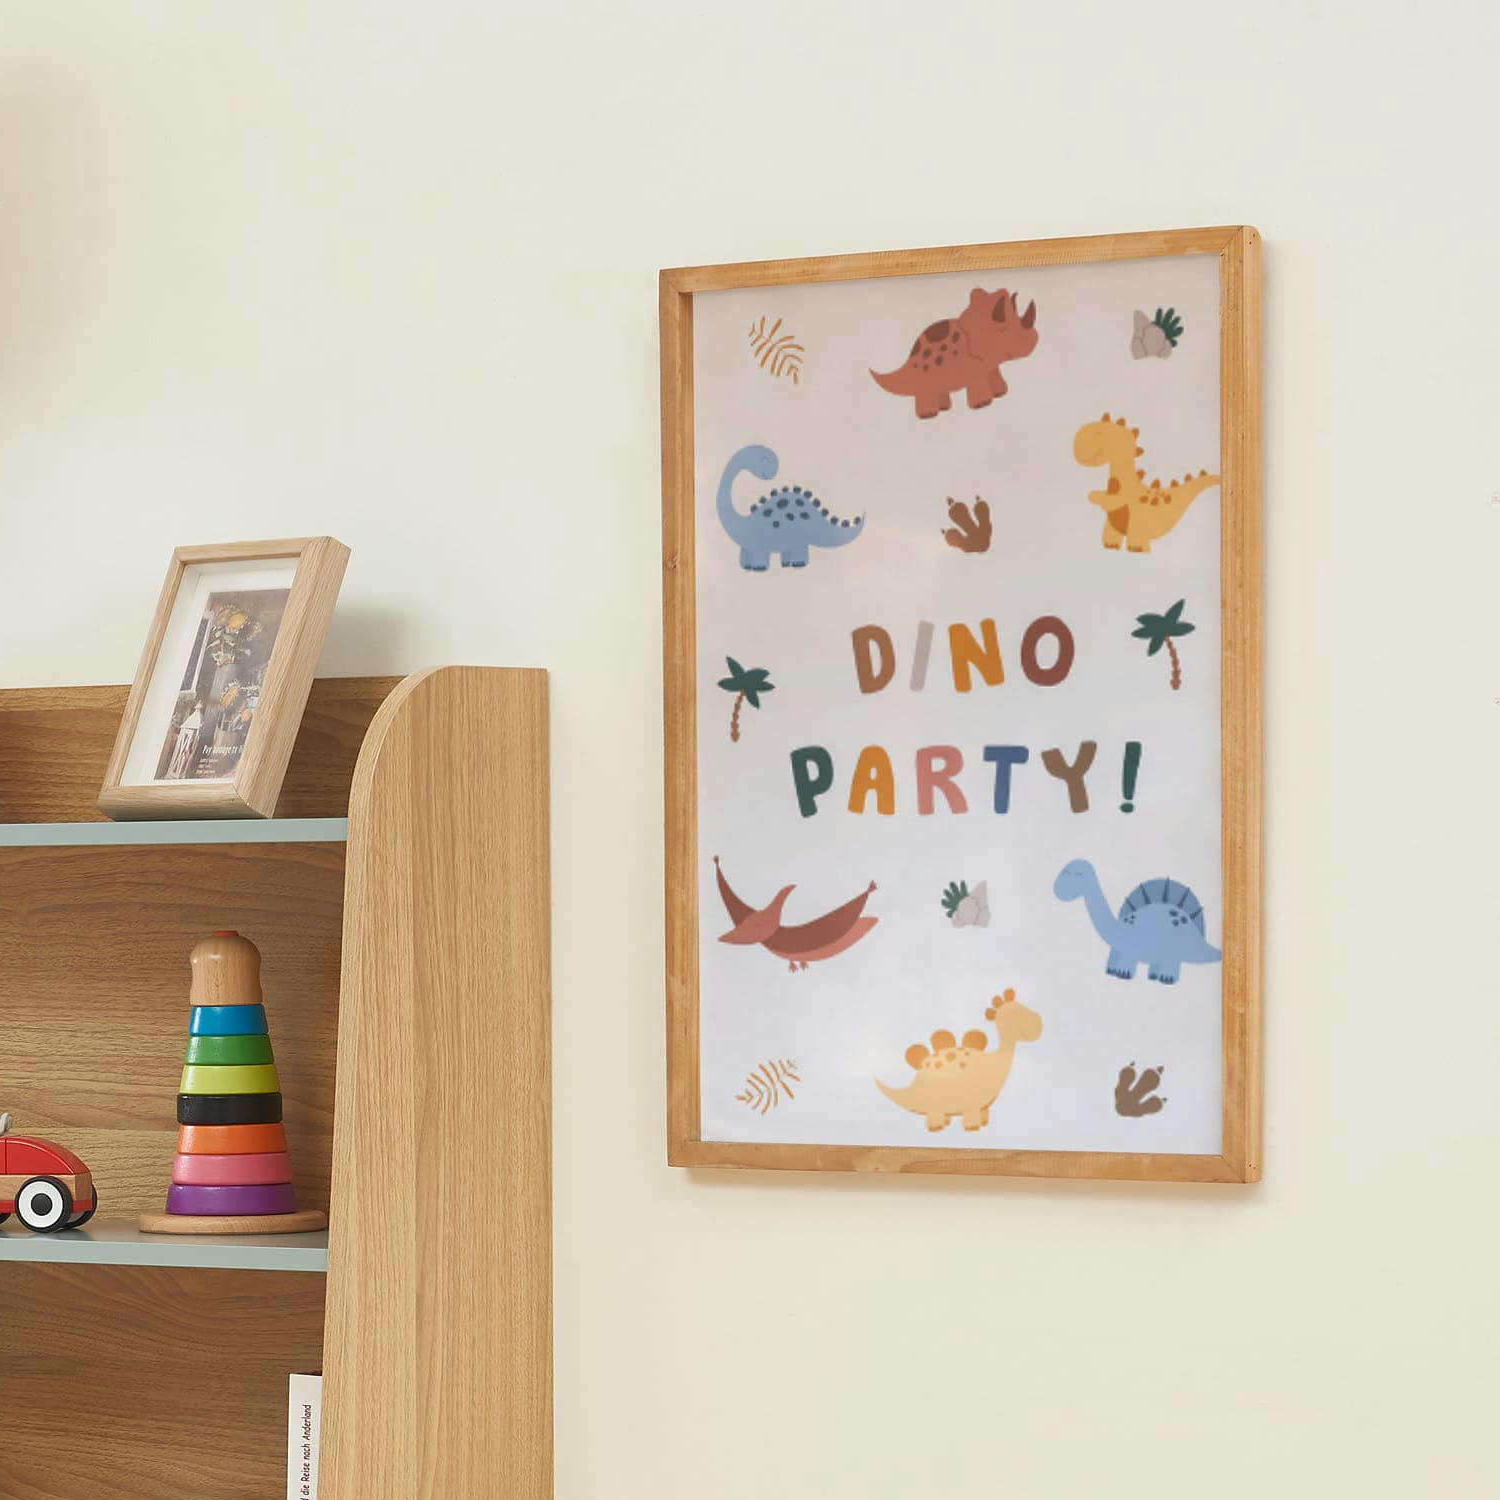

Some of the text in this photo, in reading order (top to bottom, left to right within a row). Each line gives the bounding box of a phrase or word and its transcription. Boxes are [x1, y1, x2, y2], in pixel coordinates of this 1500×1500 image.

[852, 615, 1075, 694] DINO
[790, 740, 1142, 818] PARTY!
[302, 1404, 312, 1441] Anderland
[301, 1444, 311, 1460] nach
[301, 1463, 310, 1481] Reise
[300, 1485, 310, 1495] die
